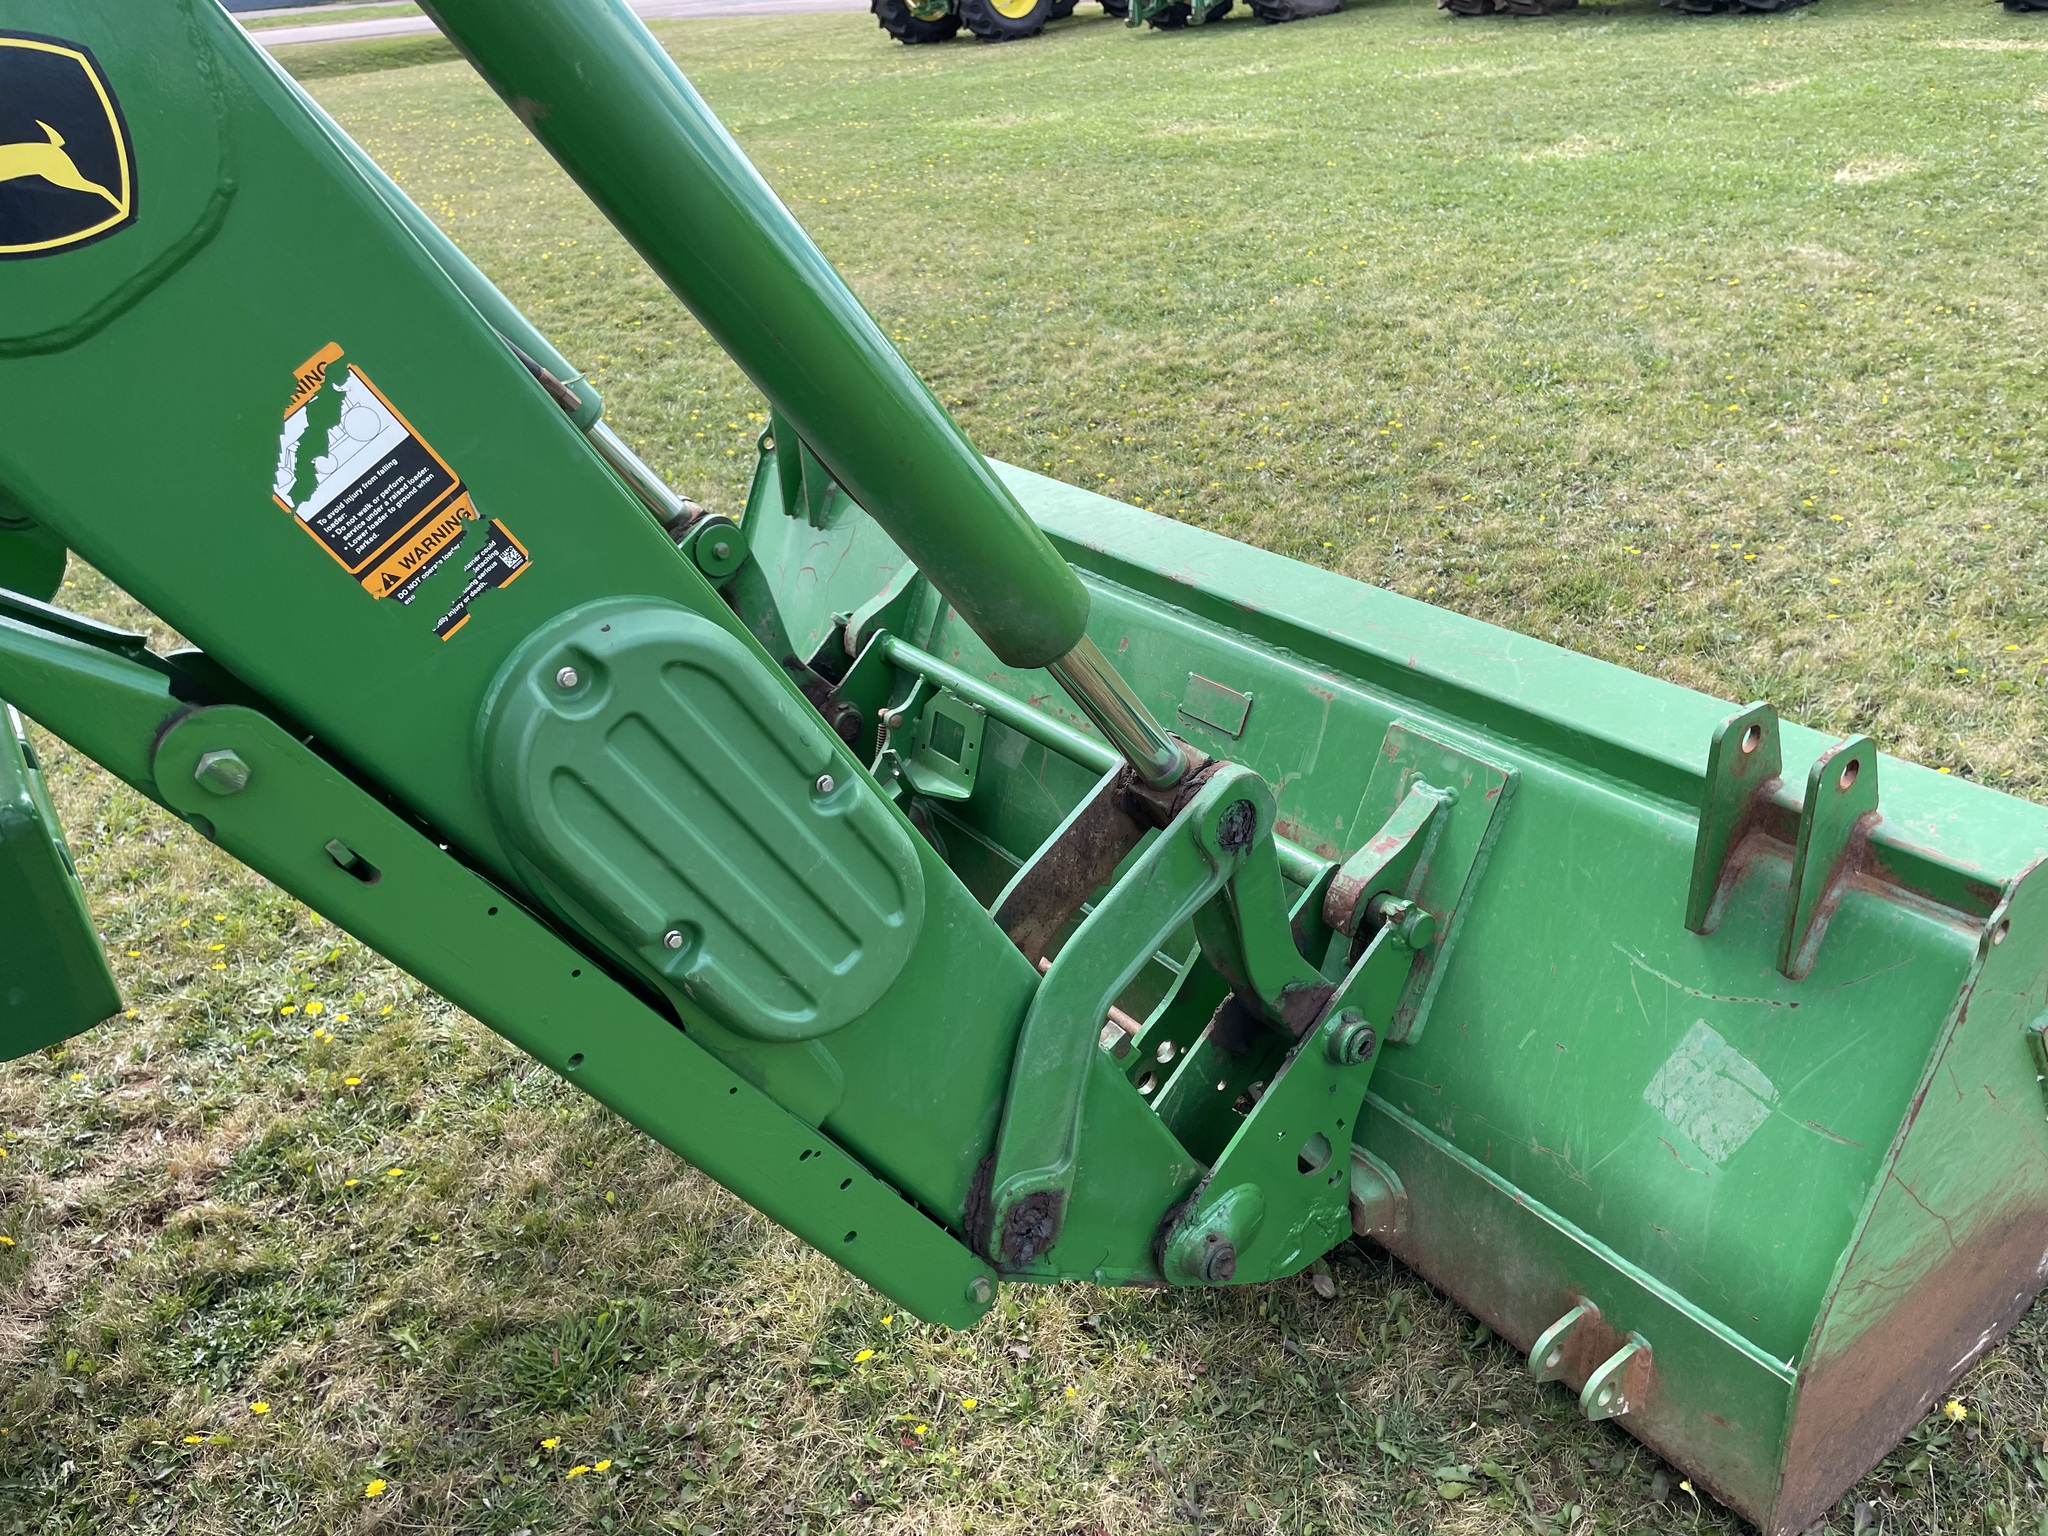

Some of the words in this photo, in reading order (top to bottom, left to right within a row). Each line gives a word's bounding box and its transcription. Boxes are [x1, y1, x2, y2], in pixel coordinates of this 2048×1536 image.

[317, 518, 327, 526] To
[327, 502, 345, 519] avoid
[343, 487, 363, 505] injury
[361, 475, 378, 489] from
[376, 458, 398, 476] falling
[335, 526, 346, 535] Do
[346, 515, 358, 527] not
[357, 503, 373, 517] walk
[372, 496, 380, 504] or
[380, 475, 405, 499] perform
[343, 520, 366, 541] service
[365, 504, 384, 522] under
[389, 483, 409, 502] raised
[407, 467, 429, 485] loader.
[323, 513, 347, 533] loader:
[347, 529, 368, 547] Lower
[367, 512, 388, 531] loader
[387, 506, 396, 514] to
[396, 486, 418, 508] ground
[417, 473, 434, 488] when
[355, 532, 380, 554] parked.
[398, 508, 471, 569] WARNING
[480, 540, 496, 556] could
[472, 550, 499, 573] etaching
[477, 561, 498, 580] serious
[397, 589, 408, 599] DO
[407, 577, 421, 591] NOT
[447, 601, 464, 617] injury
[463, 595, 470, 603] or
[470, 582, 488, 597] death.
